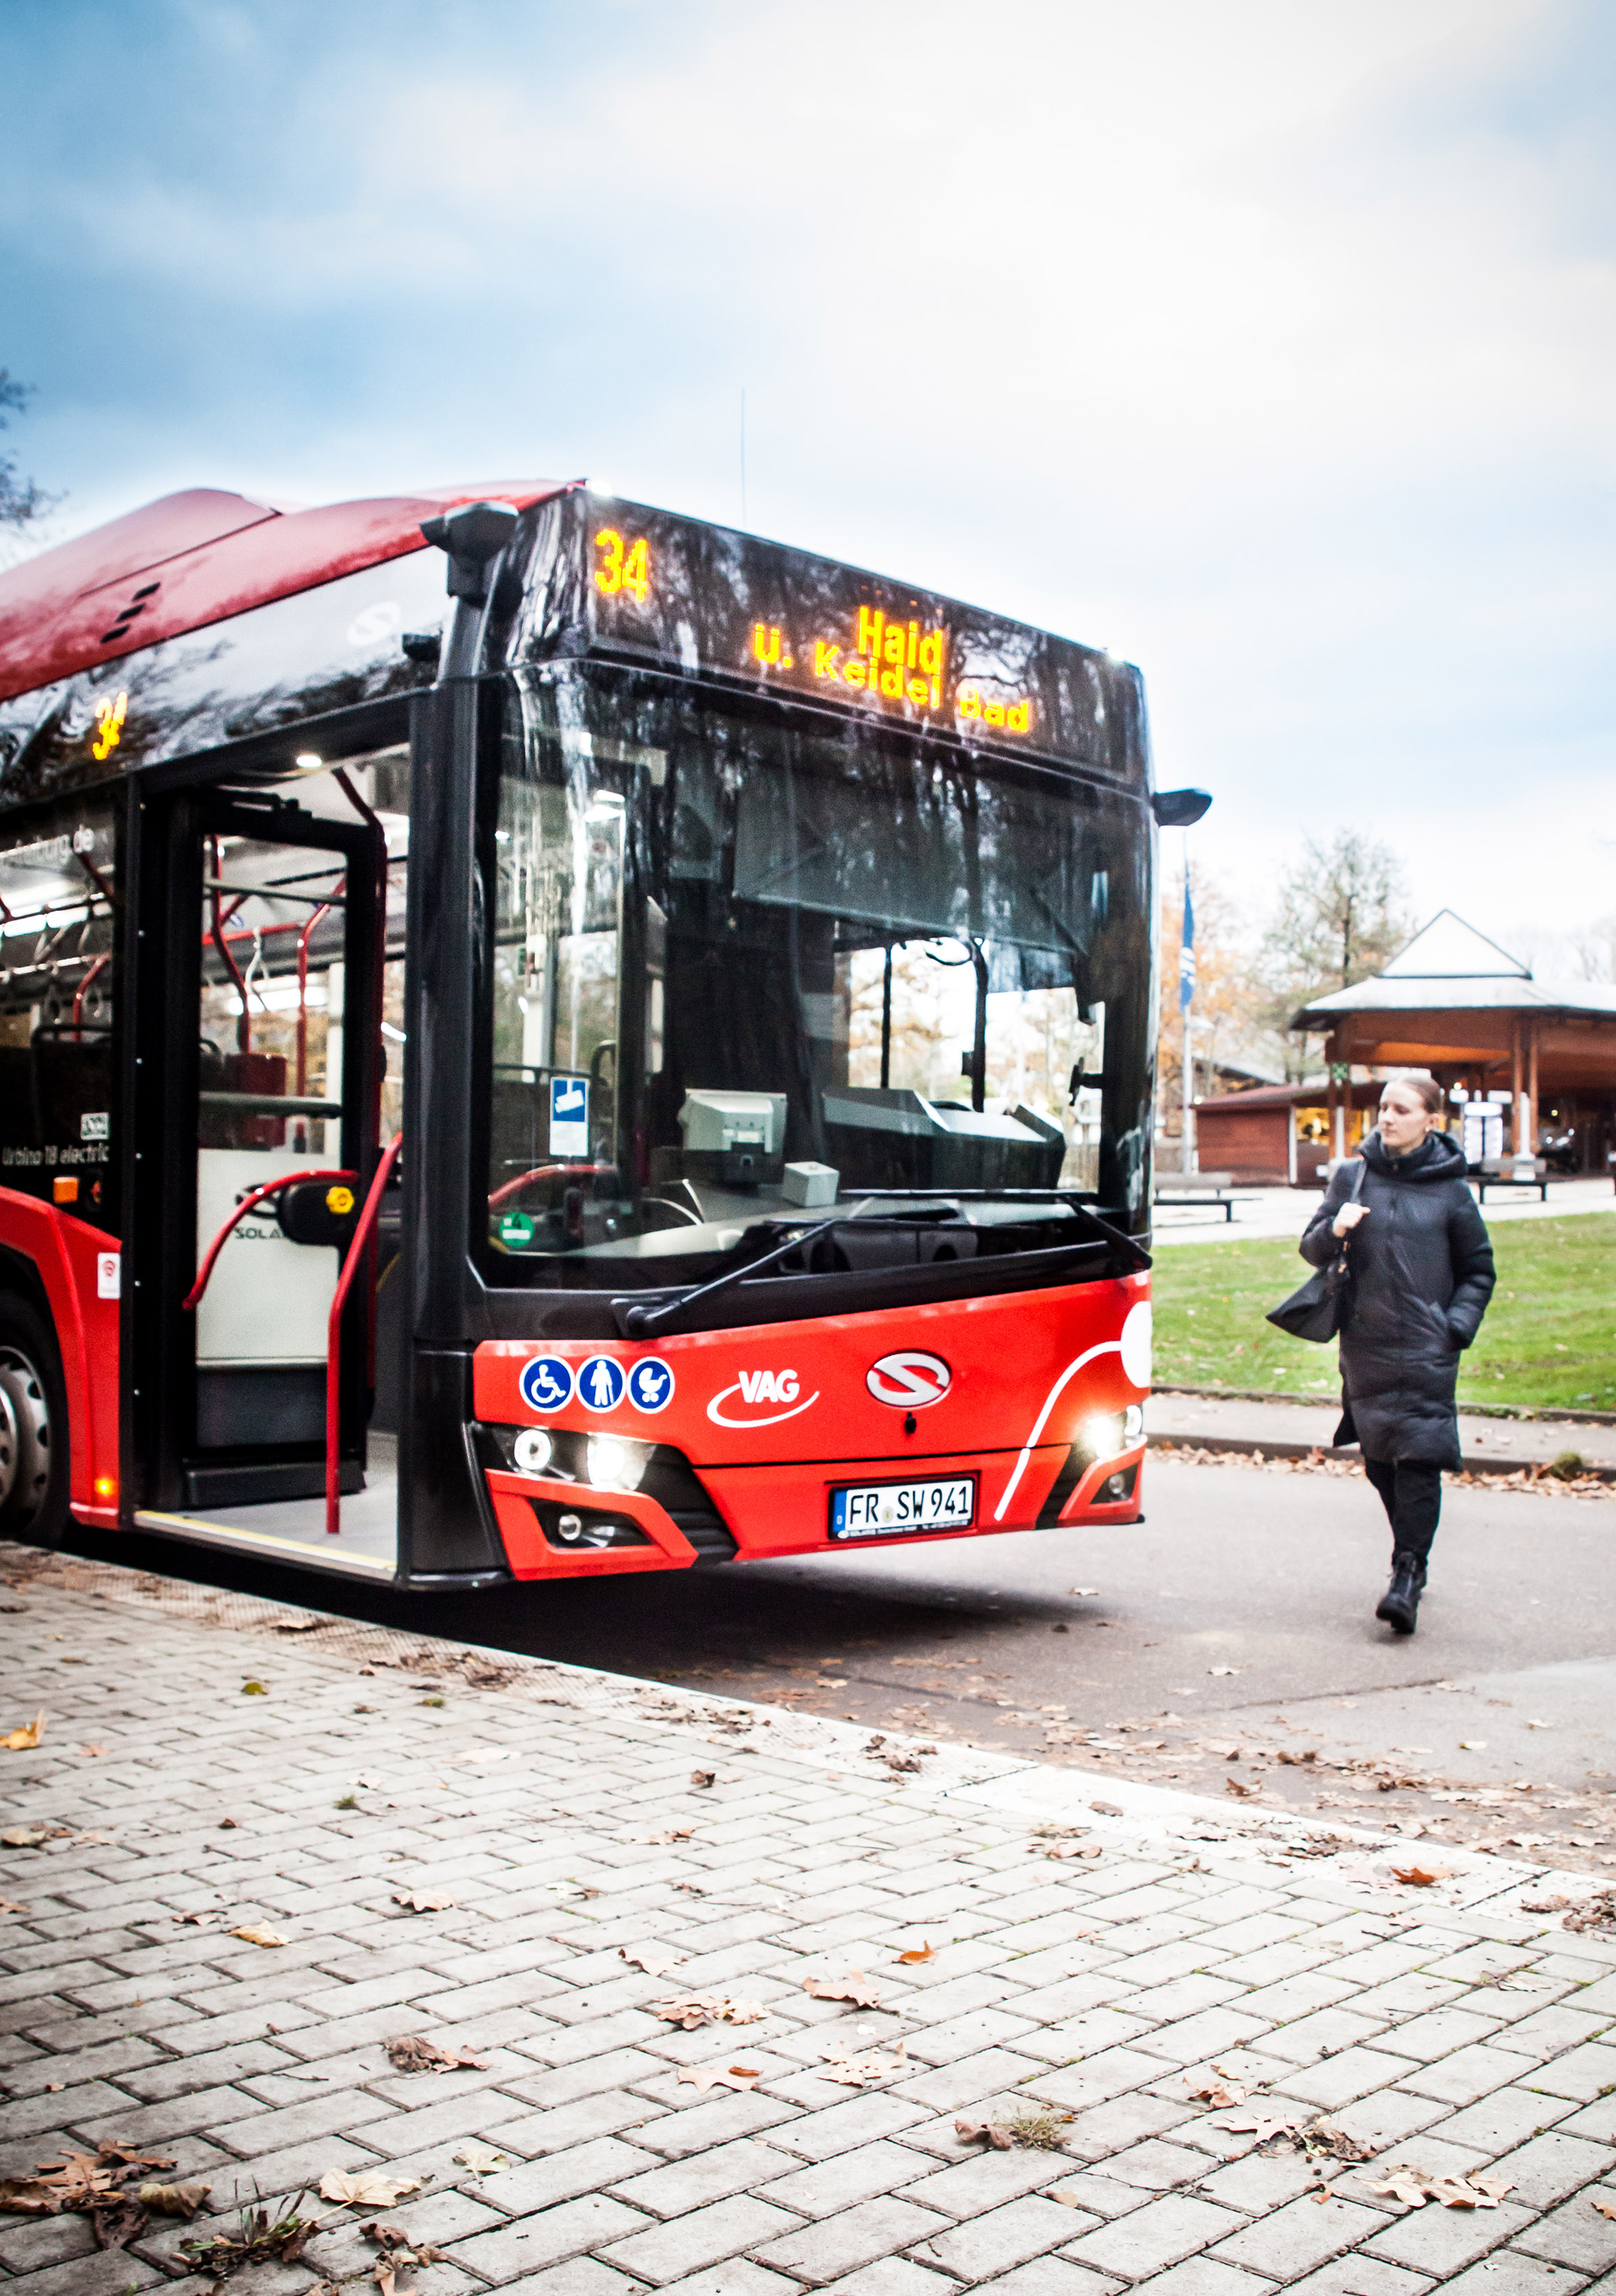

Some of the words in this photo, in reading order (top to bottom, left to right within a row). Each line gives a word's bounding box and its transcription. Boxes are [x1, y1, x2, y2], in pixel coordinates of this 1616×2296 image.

[595, 529, 647, 602] 34
[858, 605, 943, 675] Haid
[815, 641, 940, 708] Keidel
[959, 686, 1028, 732] Bad
[2, 1146, 41, 1165] Urbino
[60, 1142, 109, 1164] electric
[233, 1227, 282, 1239] SOLA
[738, 1369, 800, 1403] VAG
[850, 1493, 878, 1524] FR
[897, 1490, 924, 1519] SW
[931, 1486, 969, 1517] 941
